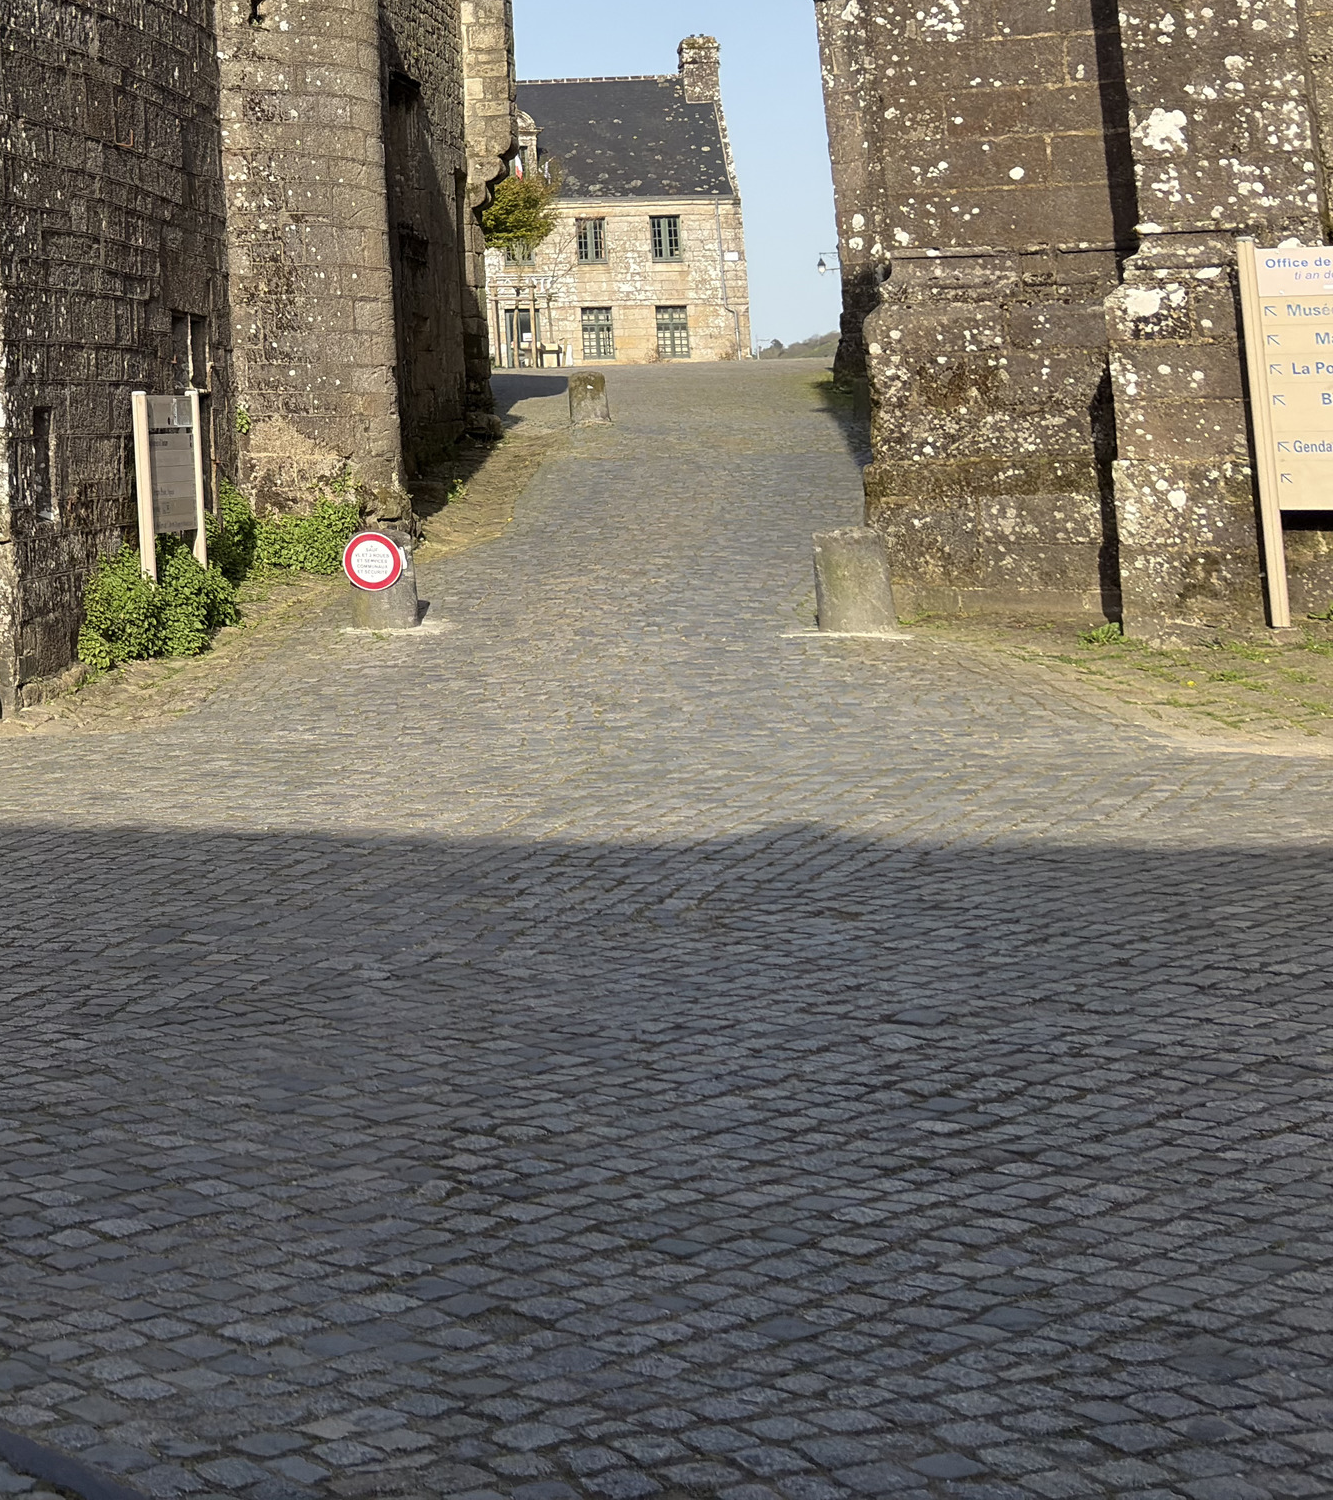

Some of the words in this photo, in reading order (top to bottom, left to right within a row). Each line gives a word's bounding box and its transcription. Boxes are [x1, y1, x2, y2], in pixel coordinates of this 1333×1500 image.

[1265, 258, 1308, 268] Office
[1314, 257, 1331, 267] de
[1286, 303, 1333, 316] Musé
[1315, 332, 1333, 344] M
[1292, 362, 1310, 375] La
